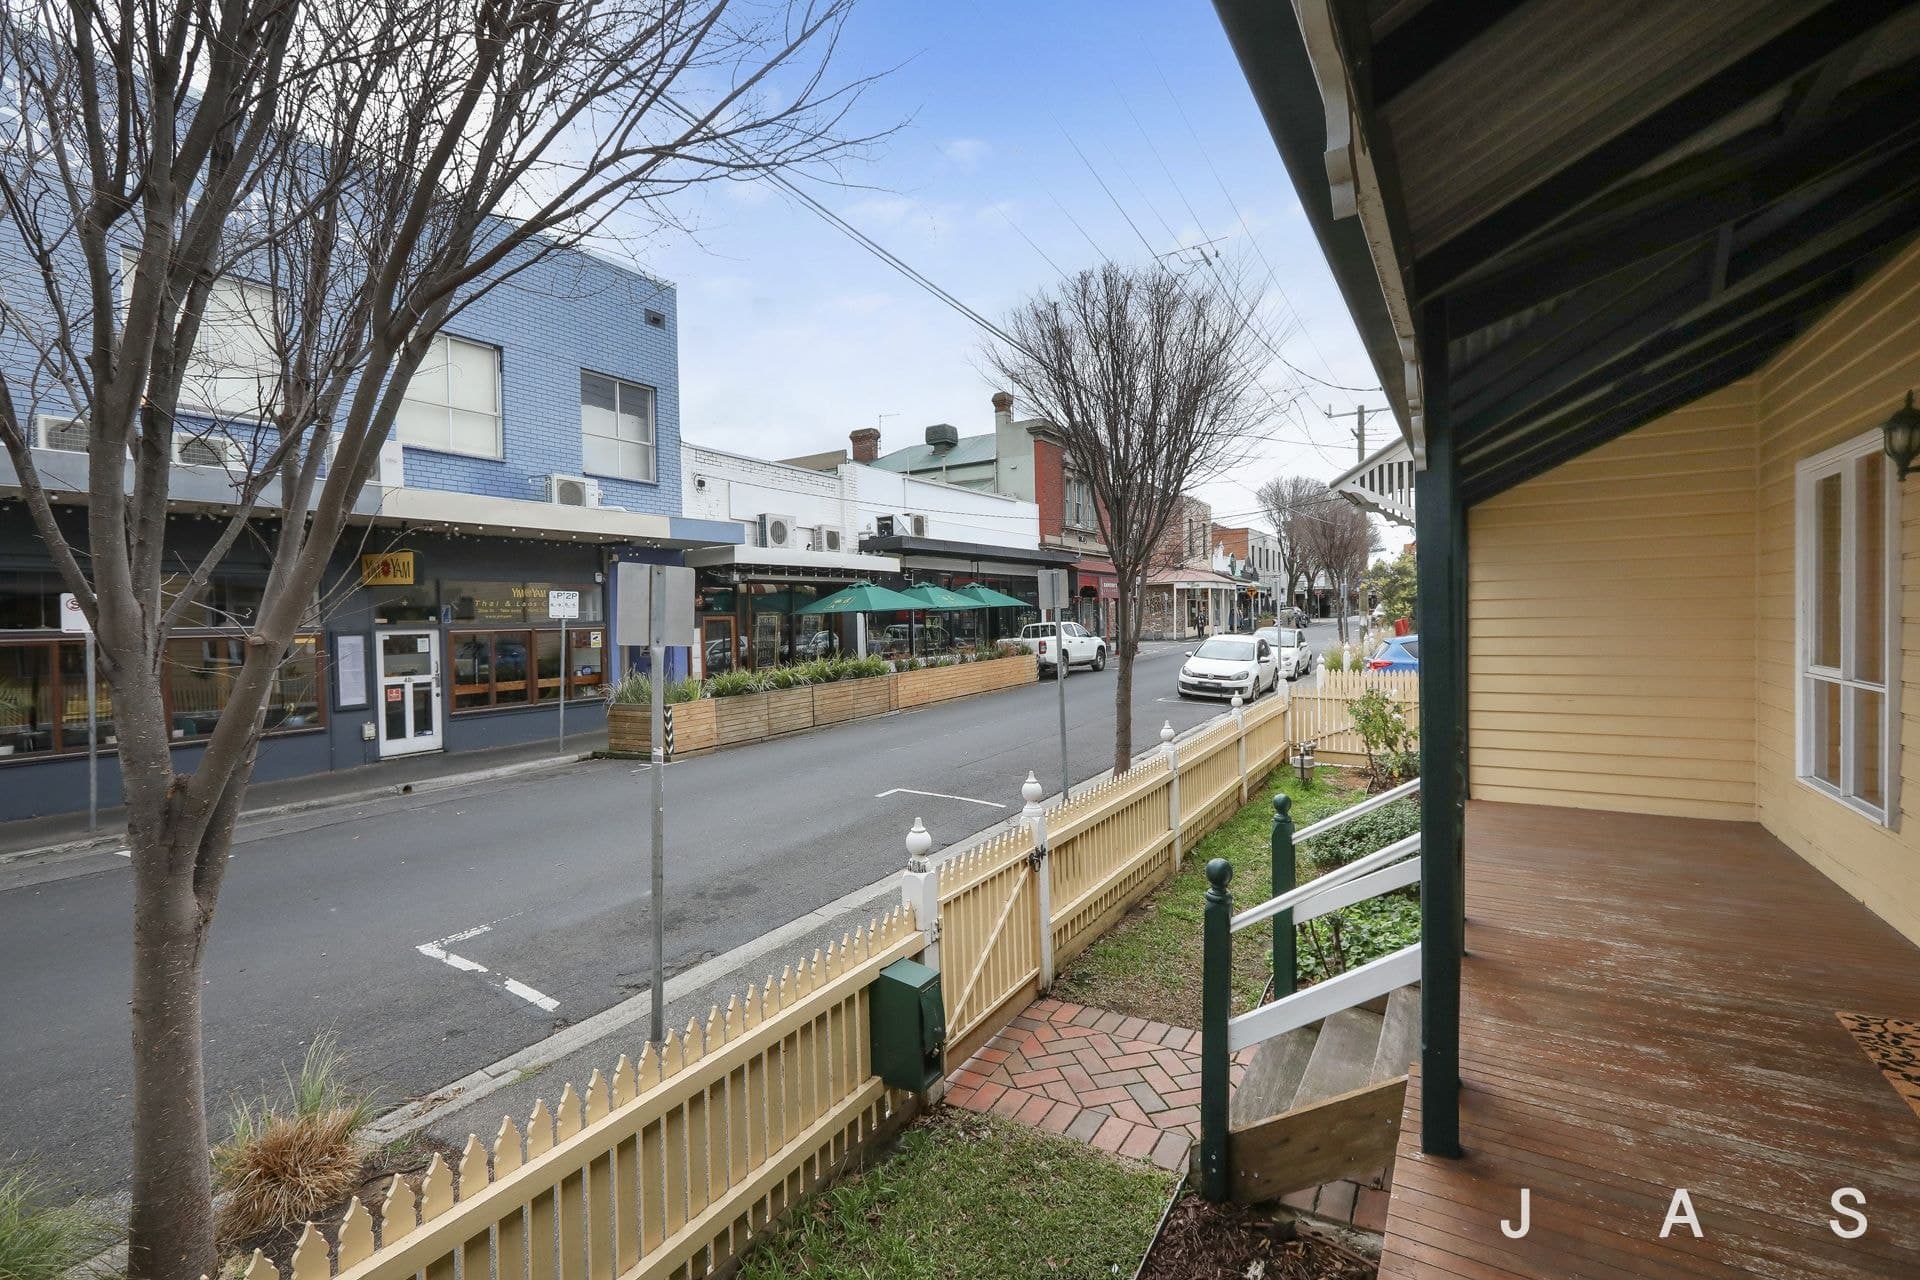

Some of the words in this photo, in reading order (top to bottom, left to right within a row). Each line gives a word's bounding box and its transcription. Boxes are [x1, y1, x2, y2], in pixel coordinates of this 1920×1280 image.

[391, 558, 411, 579] YAM
[531, 587, 547, 598] YAM
[475, 600, 499, 608] Thai
[516, 600, 538, 608] Laos
